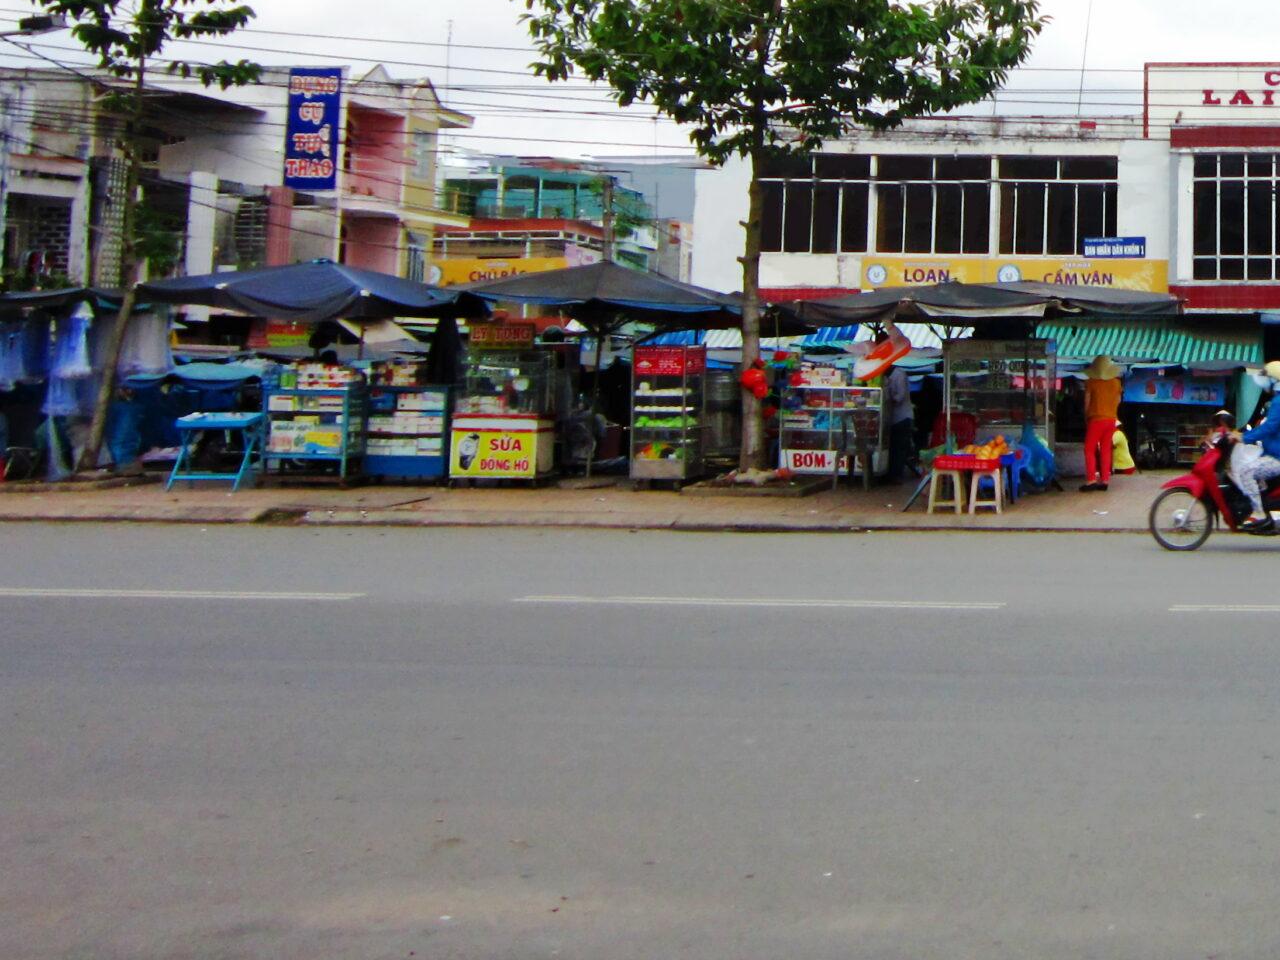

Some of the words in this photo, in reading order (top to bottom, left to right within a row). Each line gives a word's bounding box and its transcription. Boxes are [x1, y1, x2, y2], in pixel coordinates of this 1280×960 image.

[290, 76, 338, 98] DỤNG
[1203, 89, 1275, 105] LAI
[299, 102, 325, 125] CỤ
[904, 269, 950, 282] LOAN
[1081, 270, 1113, 285] VÂN
